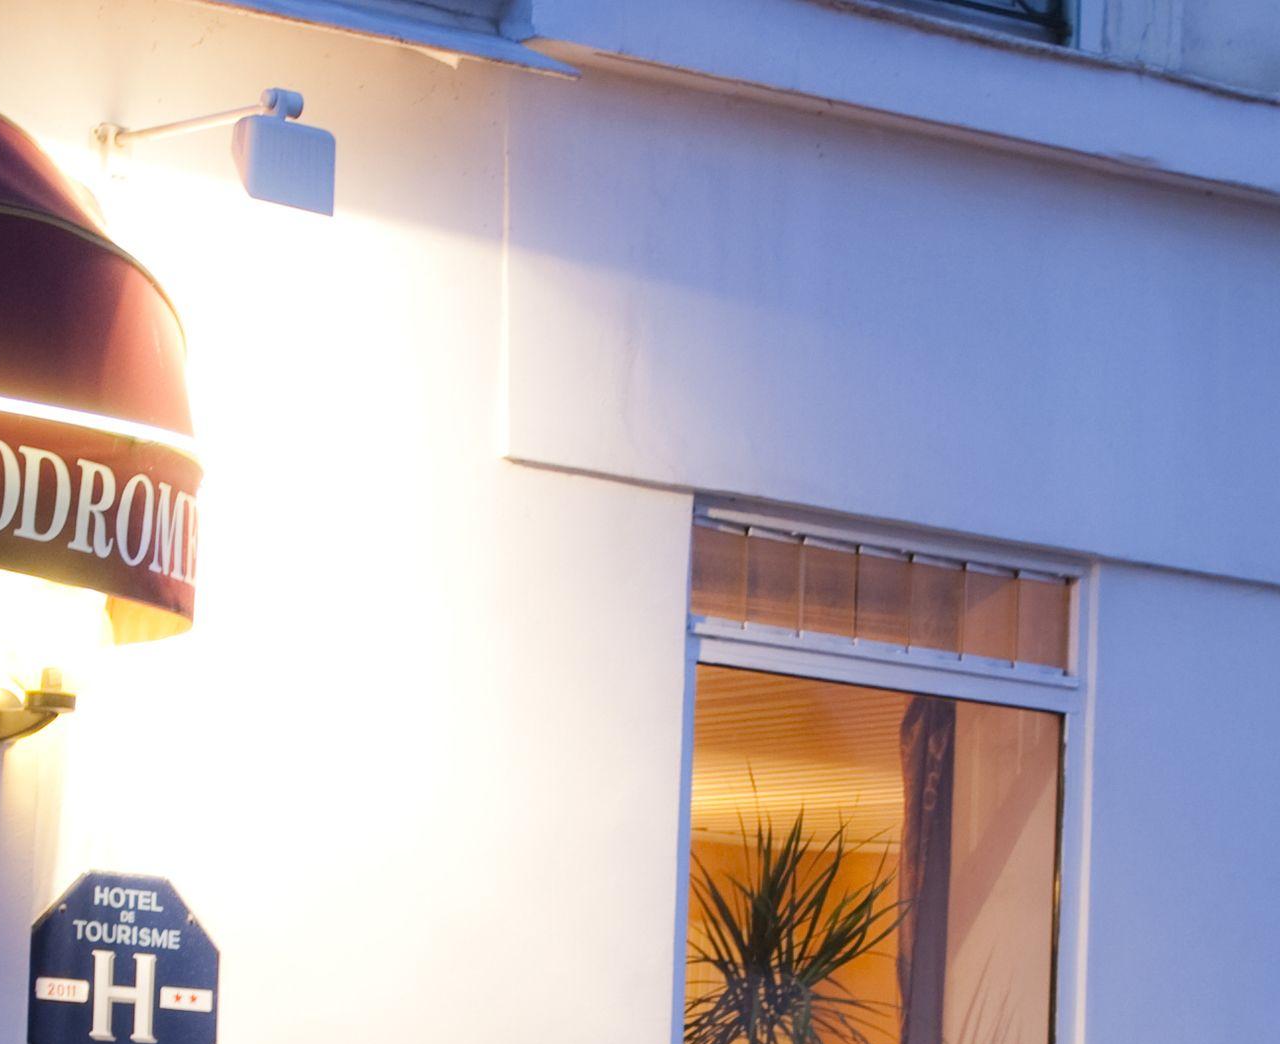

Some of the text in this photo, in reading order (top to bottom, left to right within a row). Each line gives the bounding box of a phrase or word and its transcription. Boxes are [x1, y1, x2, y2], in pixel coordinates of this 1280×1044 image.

[93, 885, 163, 912] HOTEL
[73, 919, 181, 950] TOURISME
[47, 982, 77, 997] 2011
[89, 950, 158, 1044] H
